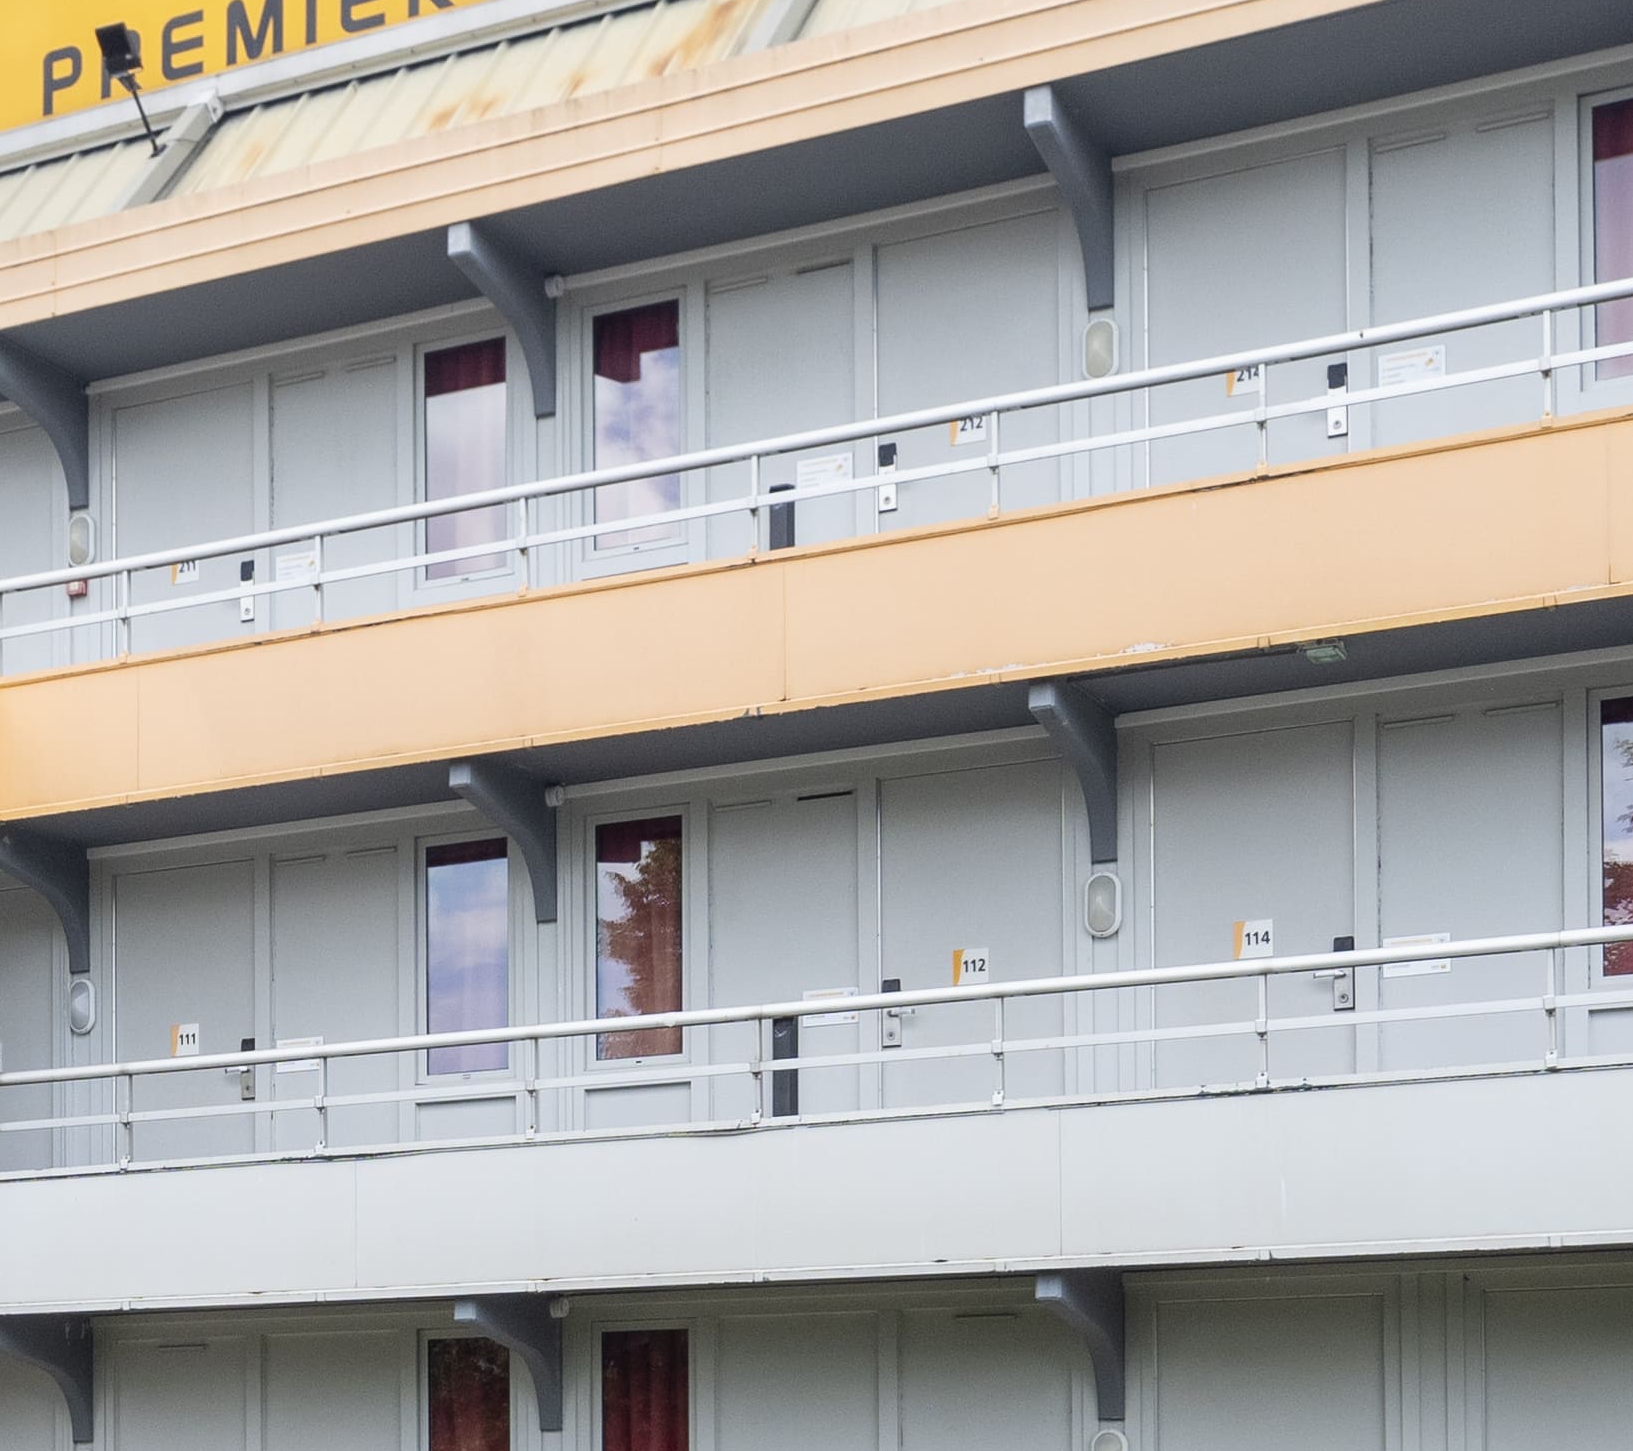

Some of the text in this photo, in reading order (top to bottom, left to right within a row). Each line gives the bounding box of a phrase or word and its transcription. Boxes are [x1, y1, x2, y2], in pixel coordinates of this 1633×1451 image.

[1237, 364, 1259, 382] 214
[960, 415, 984, 432] 212
[179, 559, 196, 574] 211
[1245, 930, 1270, 946] 114
[963, 958, 985, 973] 112
[179, 1033, 196, 1045] 111
